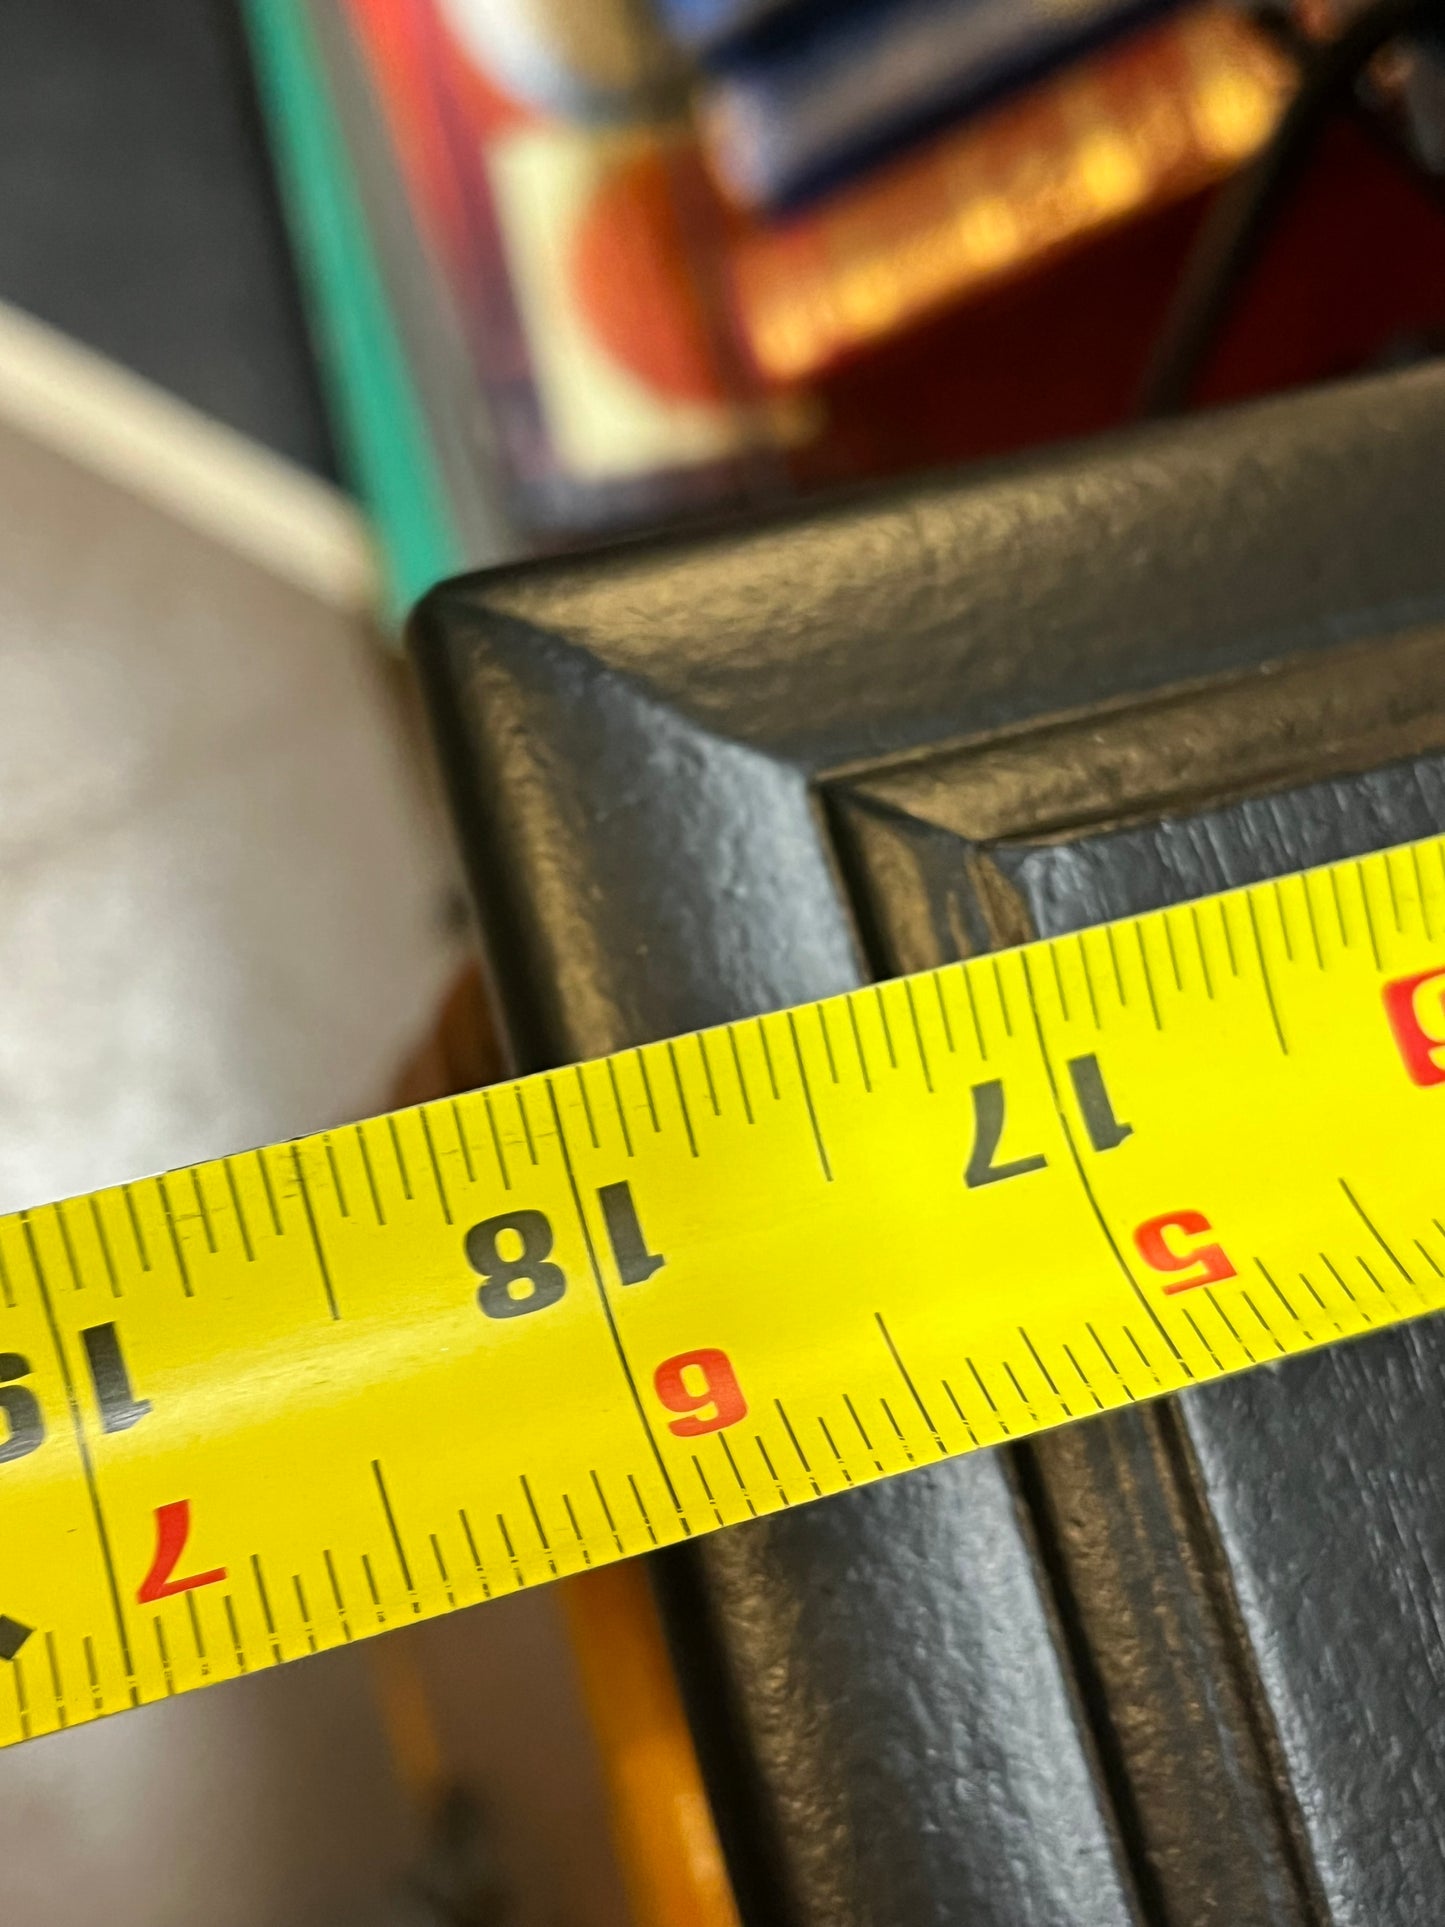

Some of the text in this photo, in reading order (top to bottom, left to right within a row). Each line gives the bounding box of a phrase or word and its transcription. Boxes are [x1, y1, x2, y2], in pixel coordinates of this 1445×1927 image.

[963, 1052, 1134, 1189] 17
[464, 1180, 666, 1319] 18
[1132, 1209, 1238, 1297] 5
[653, 1348, 748, 1437] 6
[137, 1499, 228, 1604] 7
